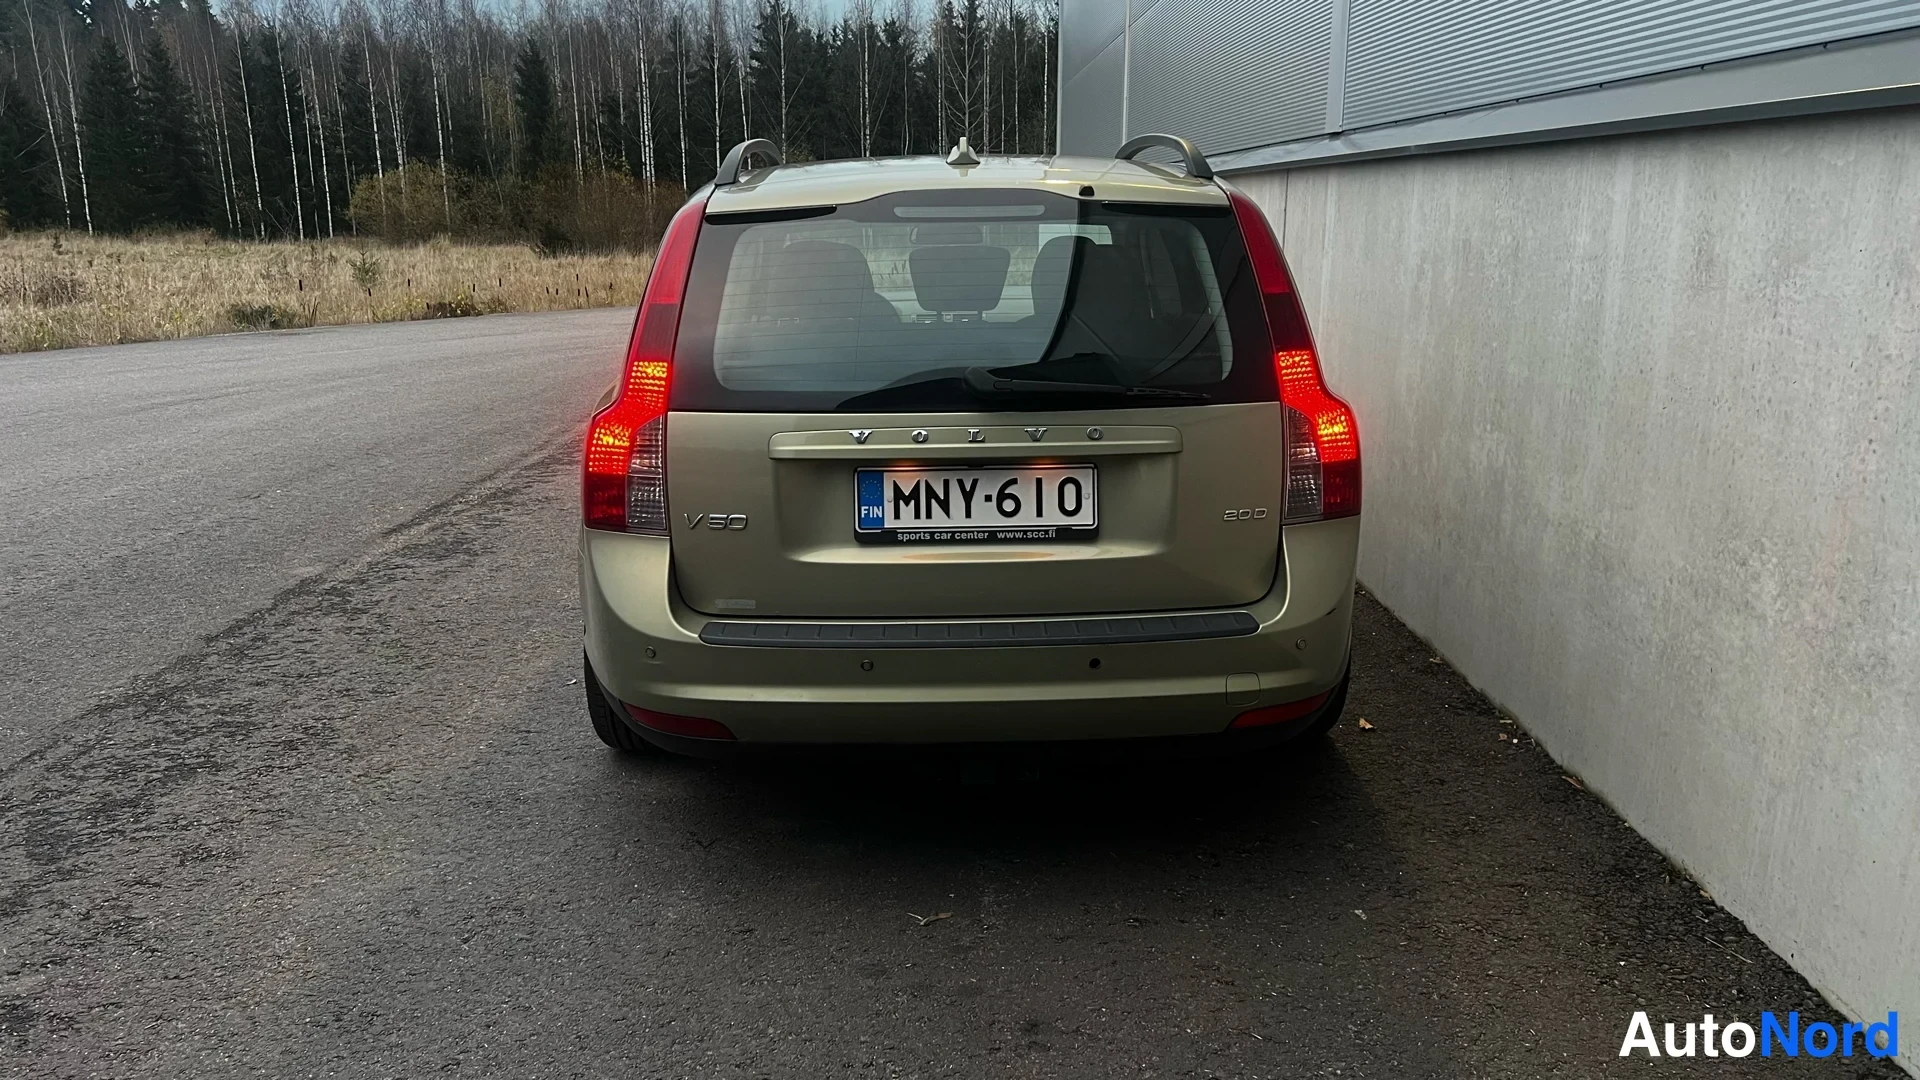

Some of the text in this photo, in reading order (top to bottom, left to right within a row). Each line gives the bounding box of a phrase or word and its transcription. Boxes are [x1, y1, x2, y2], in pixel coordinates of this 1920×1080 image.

[849, 427, 1104, 444] VOLVO
[893, 476, 1083, 520] MNY-610
[861, 505, 883, 518] FIN
[1223, 507, 1268, 521] 20D
[683, 513, 748, 530] V50
[897, 529, 1057, 541] sports car center www.scc.fi
